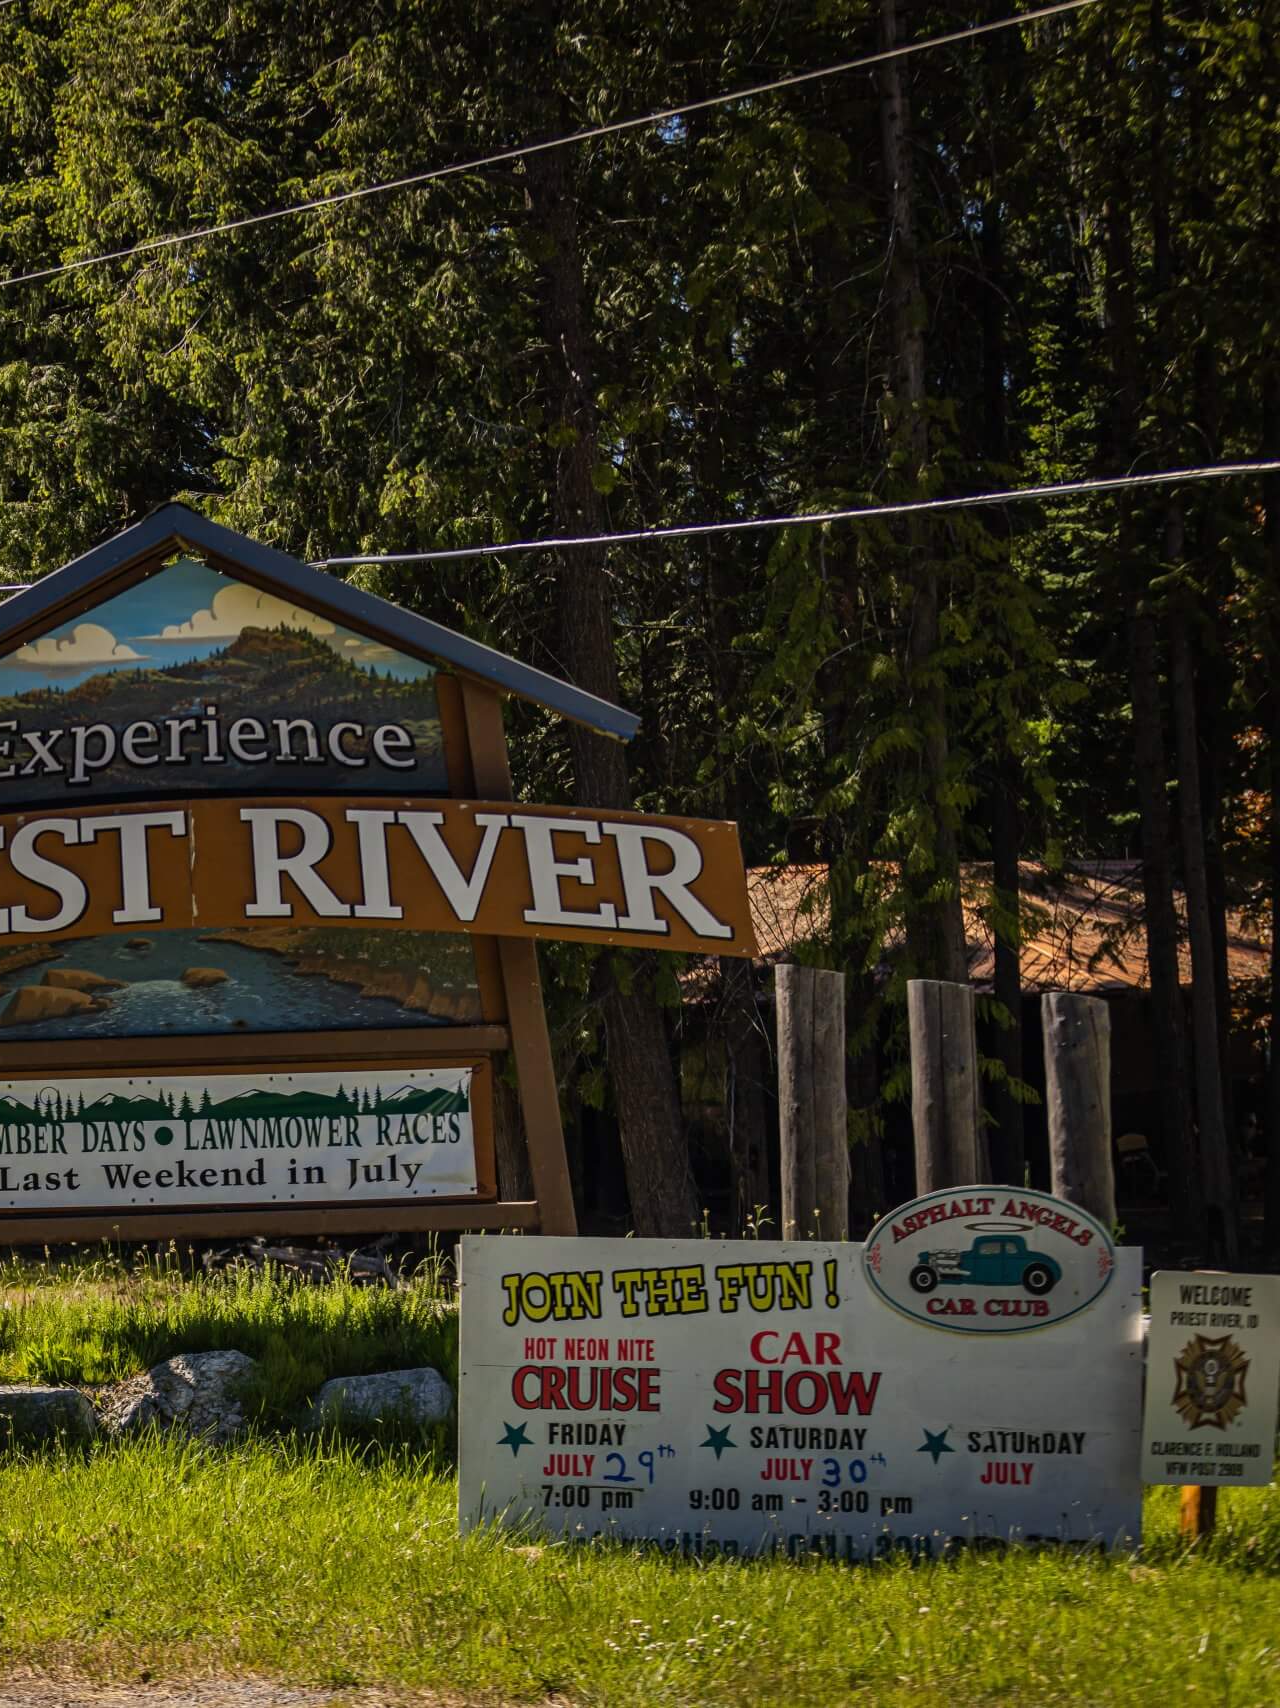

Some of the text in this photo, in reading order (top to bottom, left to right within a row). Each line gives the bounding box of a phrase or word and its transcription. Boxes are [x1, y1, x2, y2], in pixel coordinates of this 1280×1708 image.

[241, 807, 734, 941] RIVER
[81, 1120, 146, 1154] DAYS
[184, 1113, 362, 1151] LAWNMOWER
[377, 1111, 461, 1146] RACES
[103, 1158, 266, 1192] Weekend
[288, 1158, 327, 1185] in
[348, 1157, 425, 1192] July
[890, 1198, 1095, 1247] ASPHALT ANGELS
[502, 1270, 603, 1327] JOIN
[613, 1264, 709, 1317] THE
[926, 1298, 1050, 1317] CAR CLUB
[1179, 1285, 1253, 1307] WELCOME
[1171, 1311, 1208, 1327] PRIEST
[524, 1337, 655, 1361] HOT NEON NITE
[749, 1331, 843, 1365] CAR
[511, 1365, 661, 1412] CRUISE
[713, 1368, 882, 1416] SHOW
[548, 1423, 626, 1446] FRIDAY
[750, 1426, 867, 1450] SATURDAY
[967, 1431, 1086, 1455] SATURDAY
[1151, 1441, 1203, 1457] CLARENCE
[1216, 1444, 1261, 1459] HOLLAND
[543, 1454, 596, 1477] JULY
[761, 1458, 813, 1482] JULY
[980, 1462, 1034, 1486] JULY
[1189, 1462, 1216, 1477] POST
[541, 1485, 634, 1511] 7:00 pm
[689, 1488, 740, 1511] 9:00
[752, 1493, 784, 1511] am
[818, 1490, 869, 1513] 3:00
[880, 1495, 913, 1517] pm
